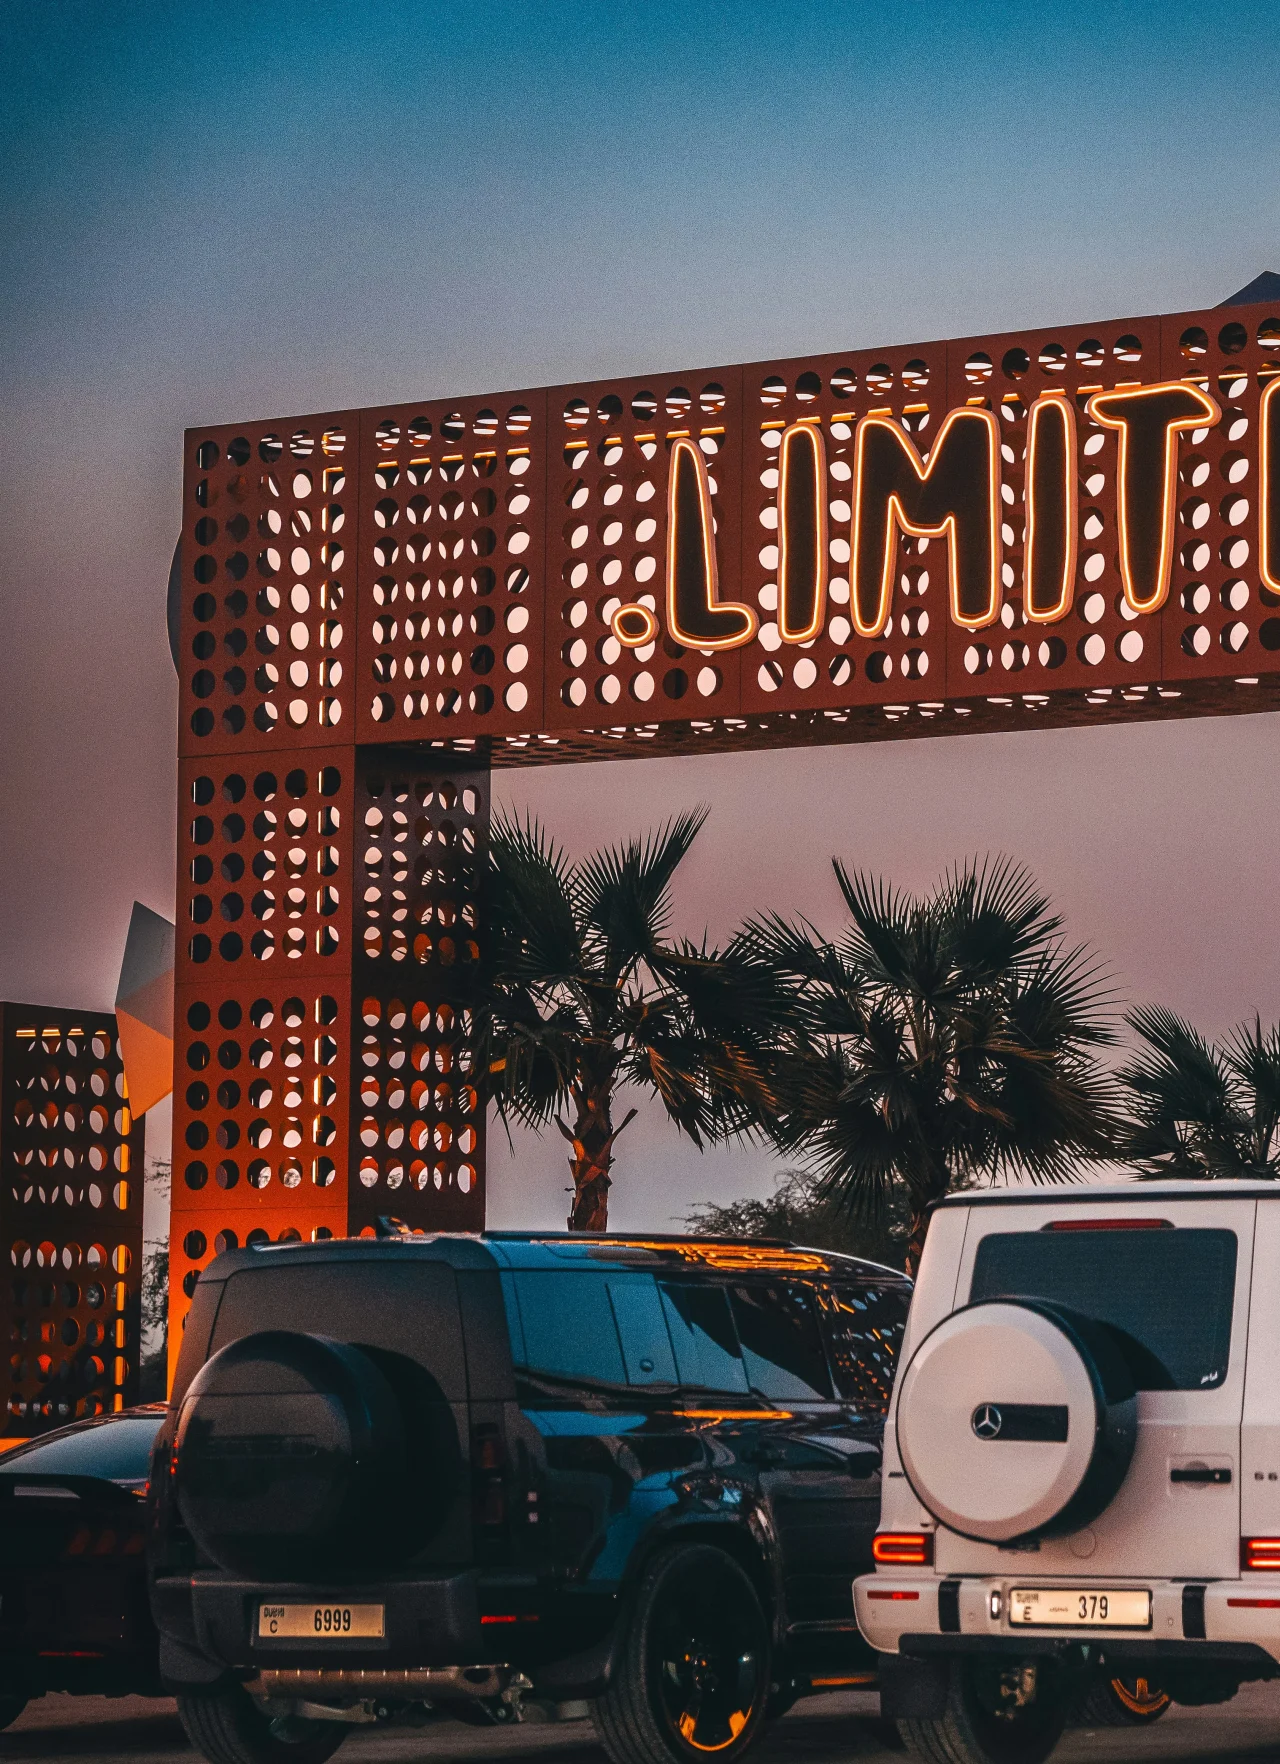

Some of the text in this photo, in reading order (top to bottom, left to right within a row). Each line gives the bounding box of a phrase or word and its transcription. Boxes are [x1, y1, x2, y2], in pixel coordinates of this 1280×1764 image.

[1023, 1595, 1109, 1620] E 379
[269, 1608, 351, 1633] C 6999
